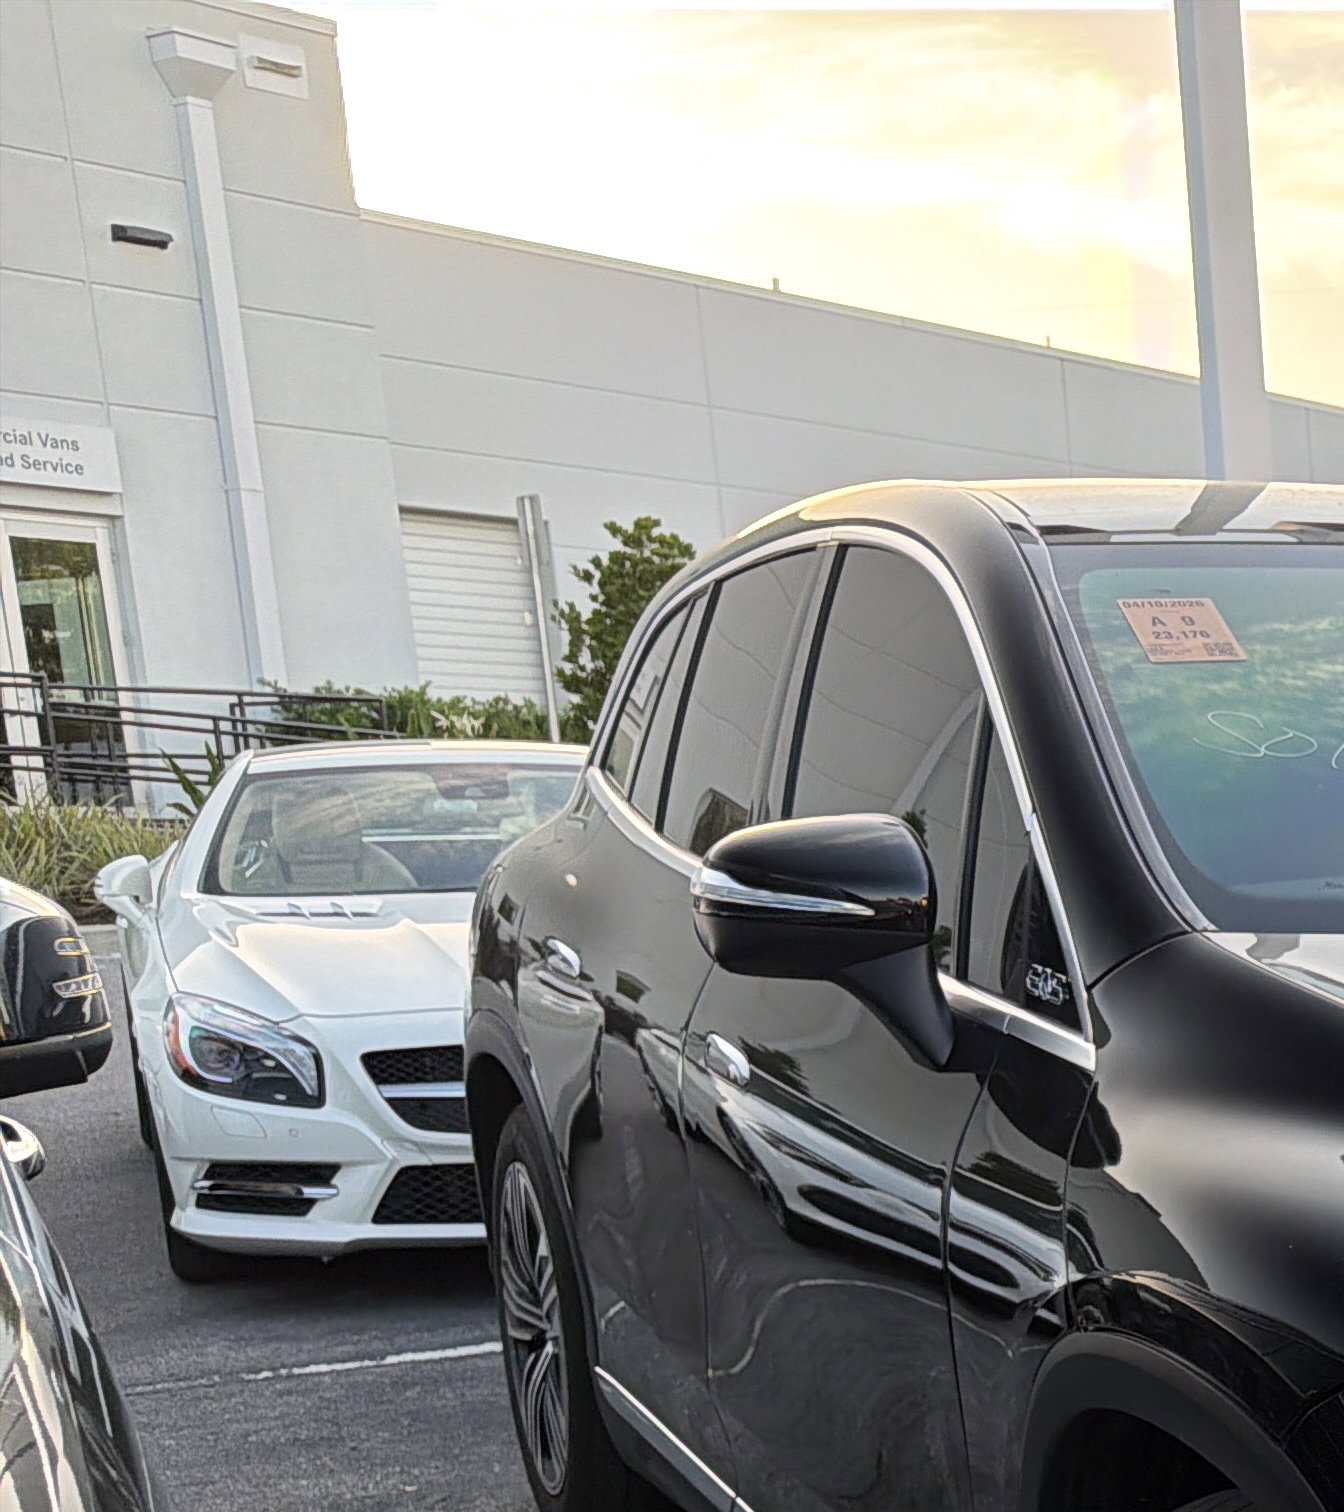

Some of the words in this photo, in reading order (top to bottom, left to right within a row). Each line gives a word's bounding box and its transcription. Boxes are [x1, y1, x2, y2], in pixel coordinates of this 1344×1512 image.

[0, 428, 33, 447] cial
[37, 431, 80, 452] Vans
[20, 453, 85, 476] Service
[1151, 616, 1168, 627] A
